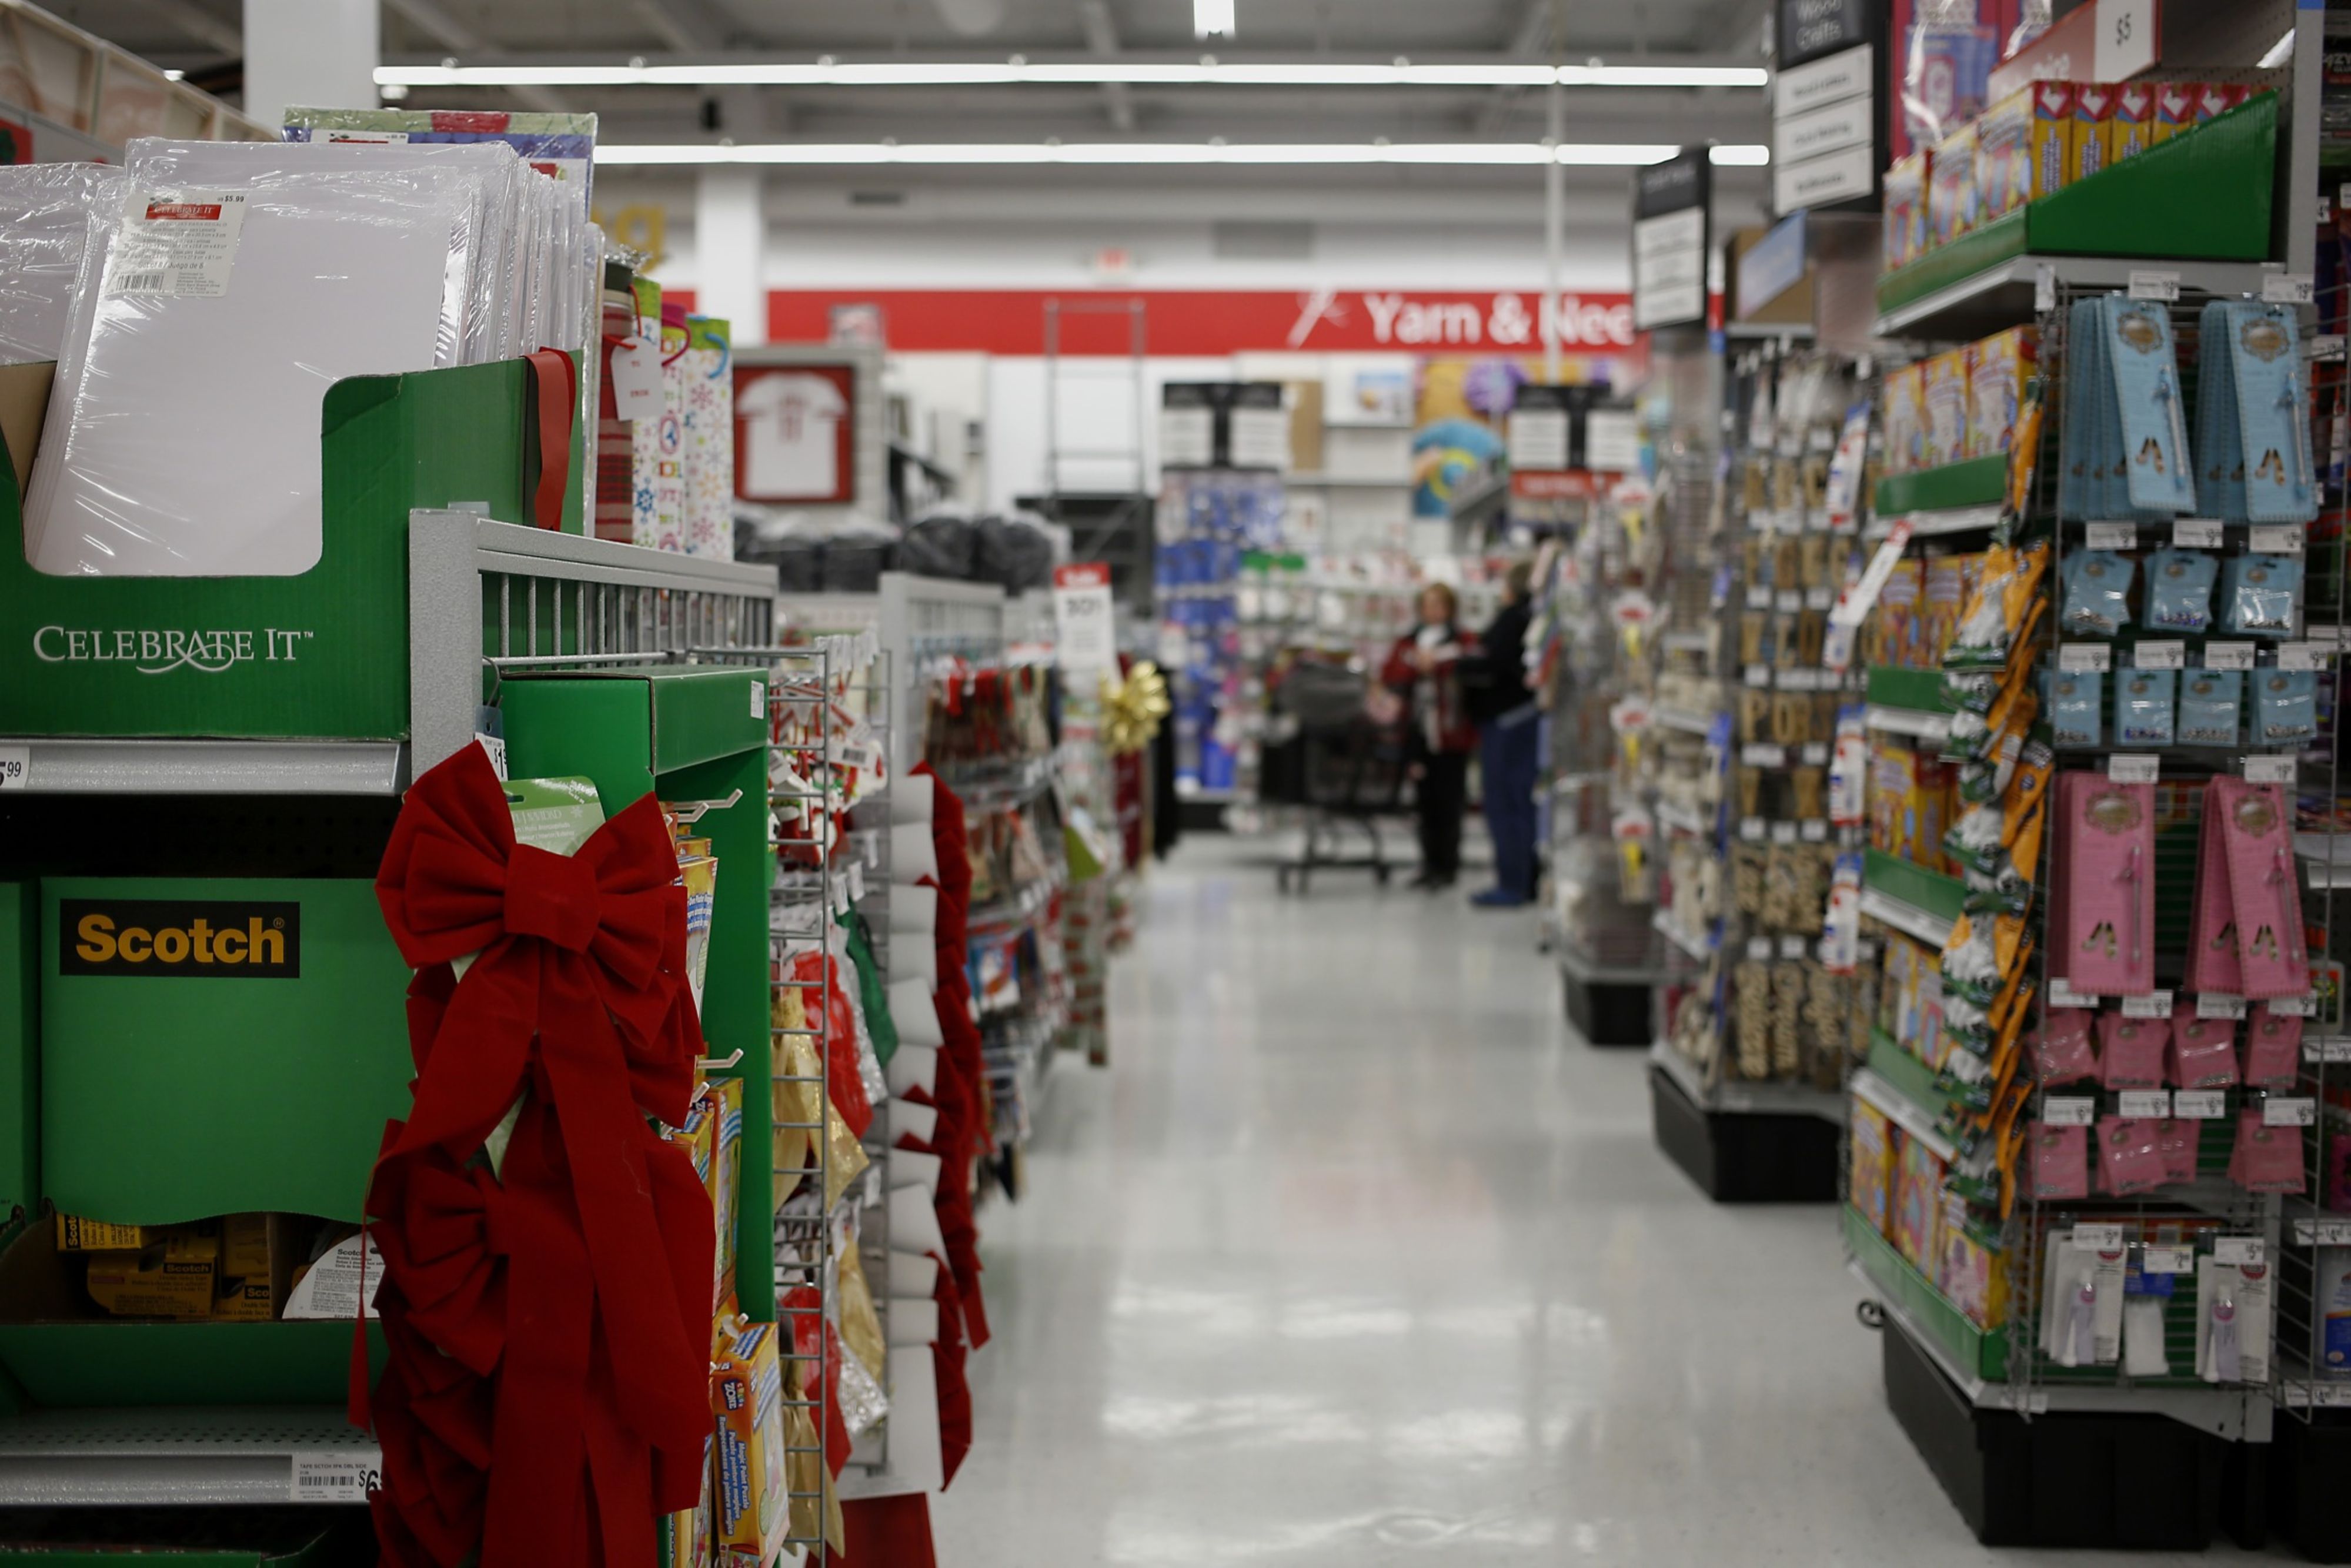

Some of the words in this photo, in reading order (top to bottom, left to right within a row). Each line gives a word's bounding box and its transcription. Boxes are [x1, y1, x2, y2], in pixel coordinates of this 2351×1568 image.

[2115, 12, 2132, 45] $5
[1363, 293, 1481, 345] Yarn
[1487, 293, 1531, 345] &
[33, 626, 254, 674] CELEBRATE
[166, 1264, 209, 1273] Scotch
[724, 1382, 737, 1410] ZONE
[719, 1415, 729, 1470] Rompecabezas
[728, 1432, 737, 1455] Puzzle
[738, 1442, 747, 1465] Magic
[722, 1470, 730, 1479] de
[730, 1456, 739, 1487] peinture
[740, 1465, 749, 1485] Paint
[722, 1481, 732, 1507] pintura
[732, 1488, 742, 1519] magique
[742, 1485, 750, 1510] Puzzle
